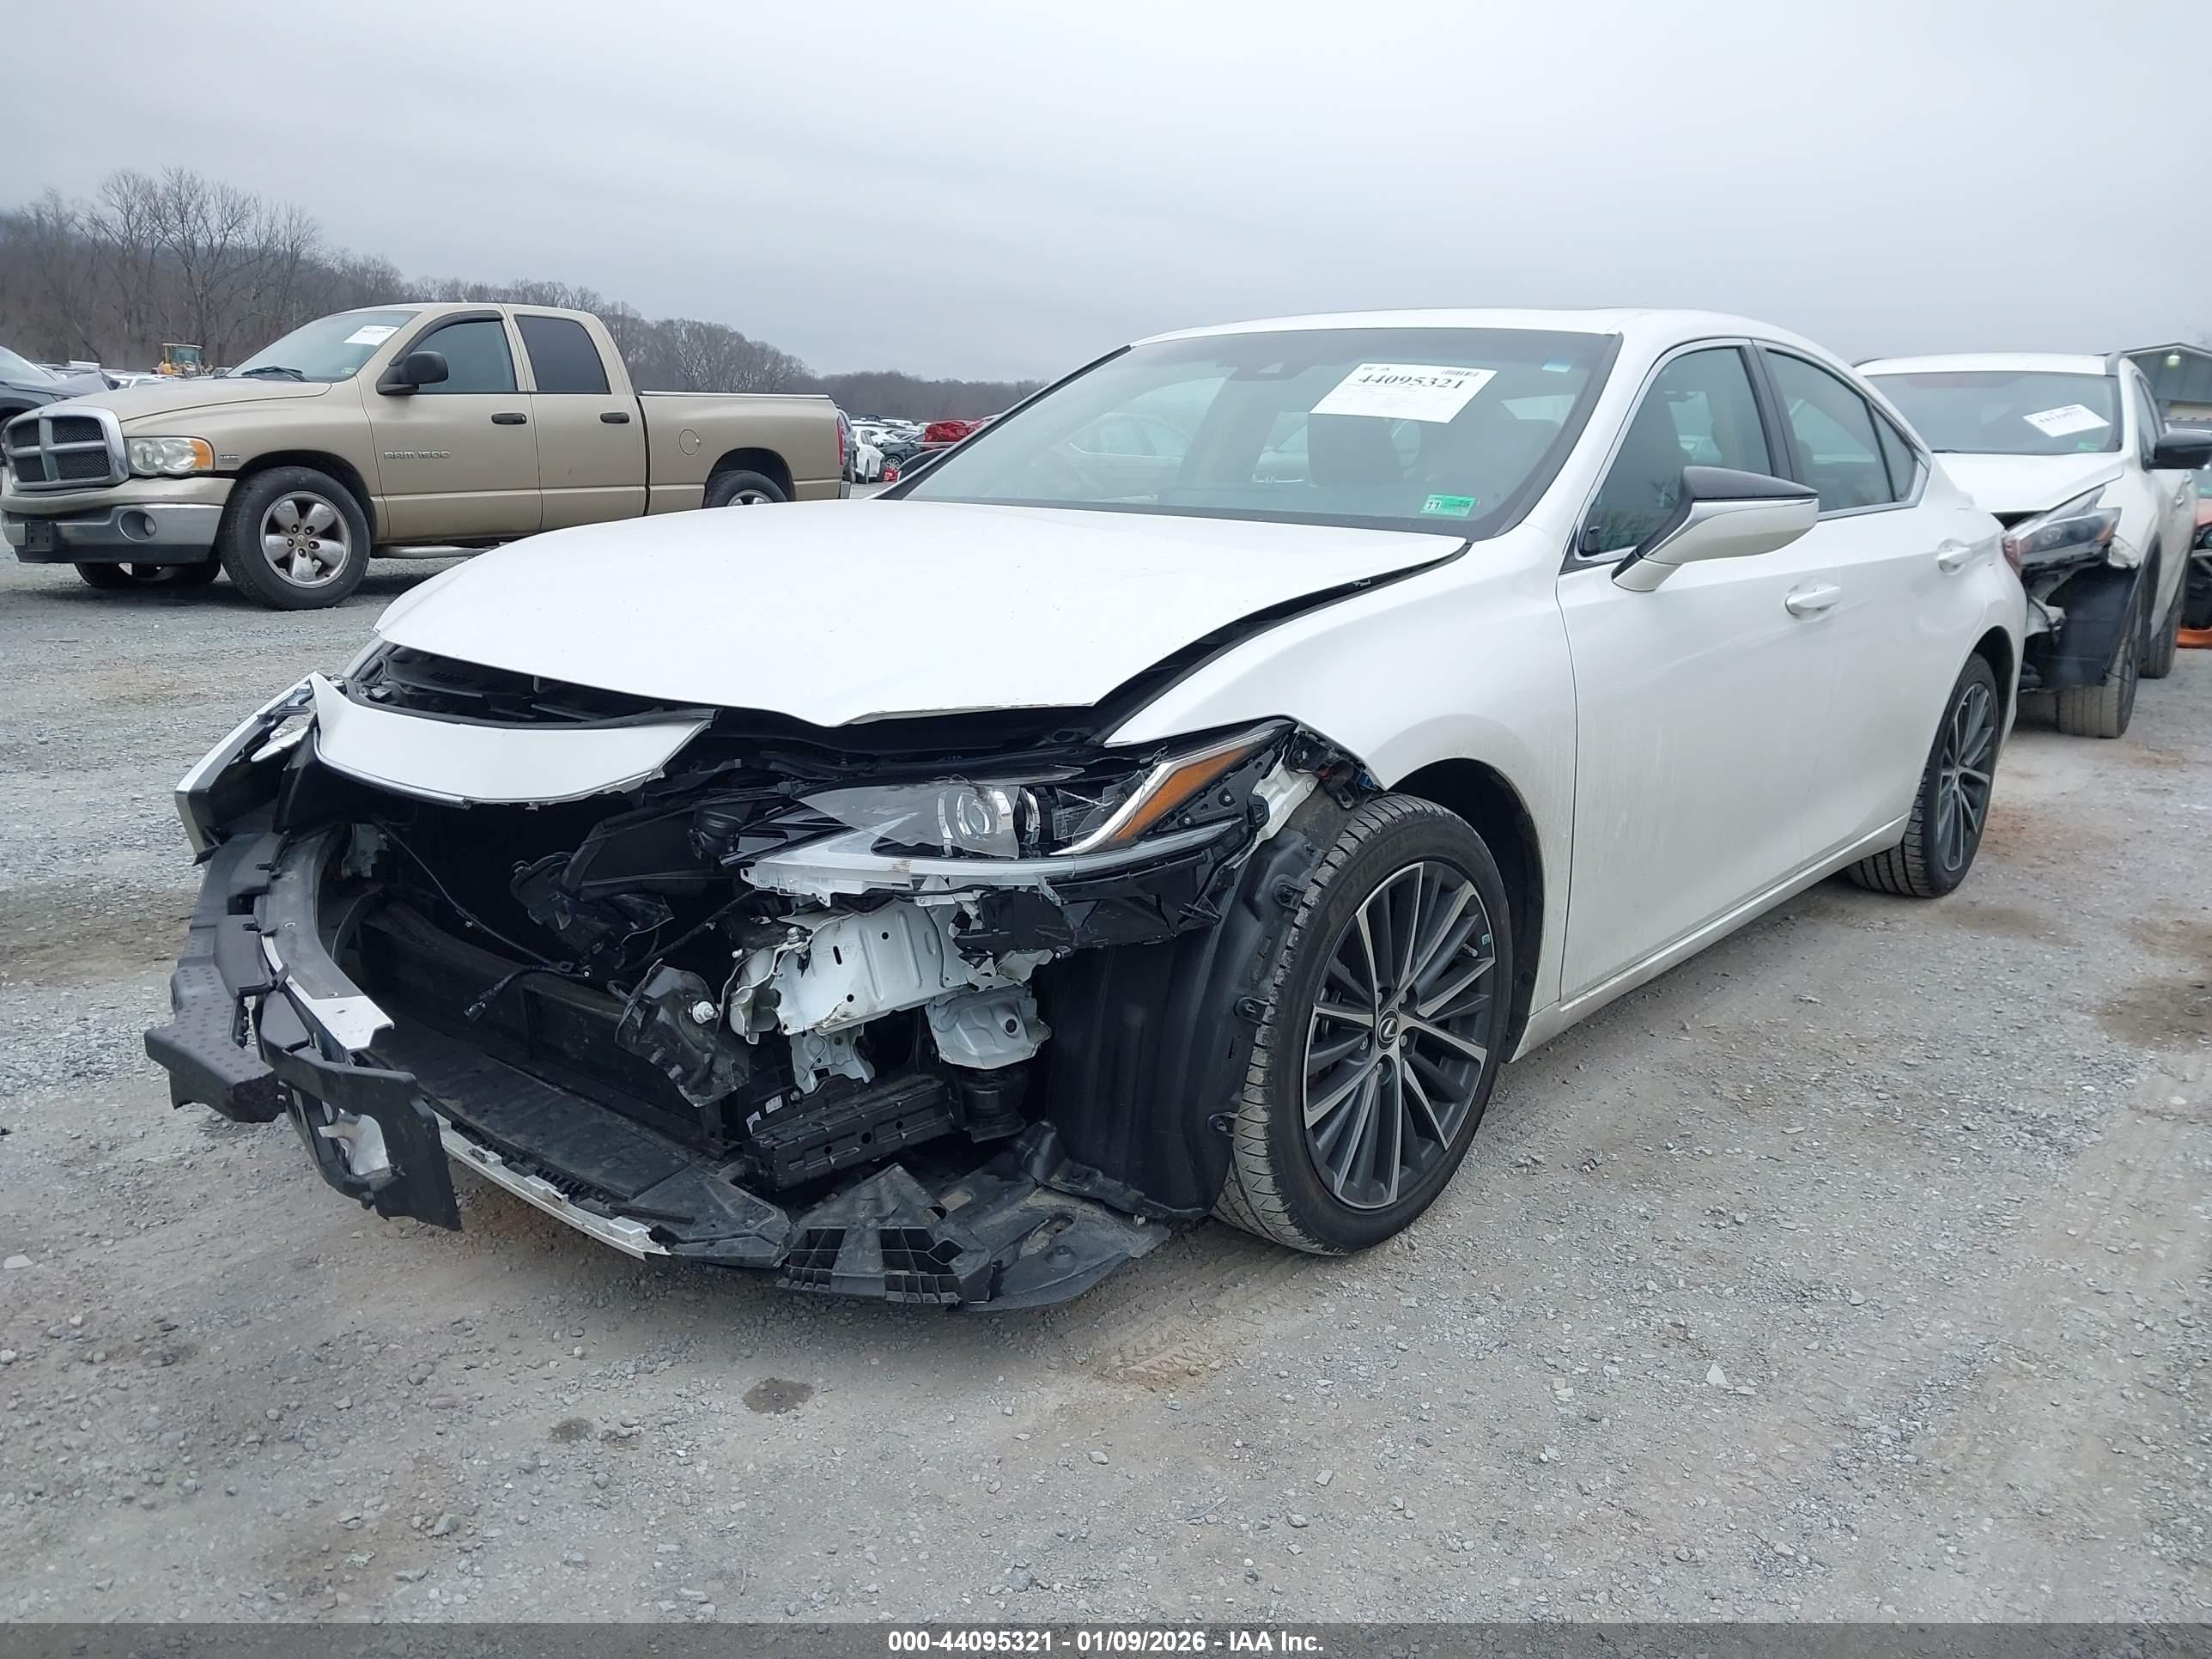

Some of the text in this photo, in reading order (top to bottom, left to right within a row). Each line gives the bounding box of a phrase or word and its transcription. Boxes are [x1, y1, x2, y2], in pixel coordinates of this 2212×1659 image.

[1358, 374, 1465, 389] 44095321
[384, 451, 451, 459] RAM 1500
[1427, 501, 1440, 510] 11
